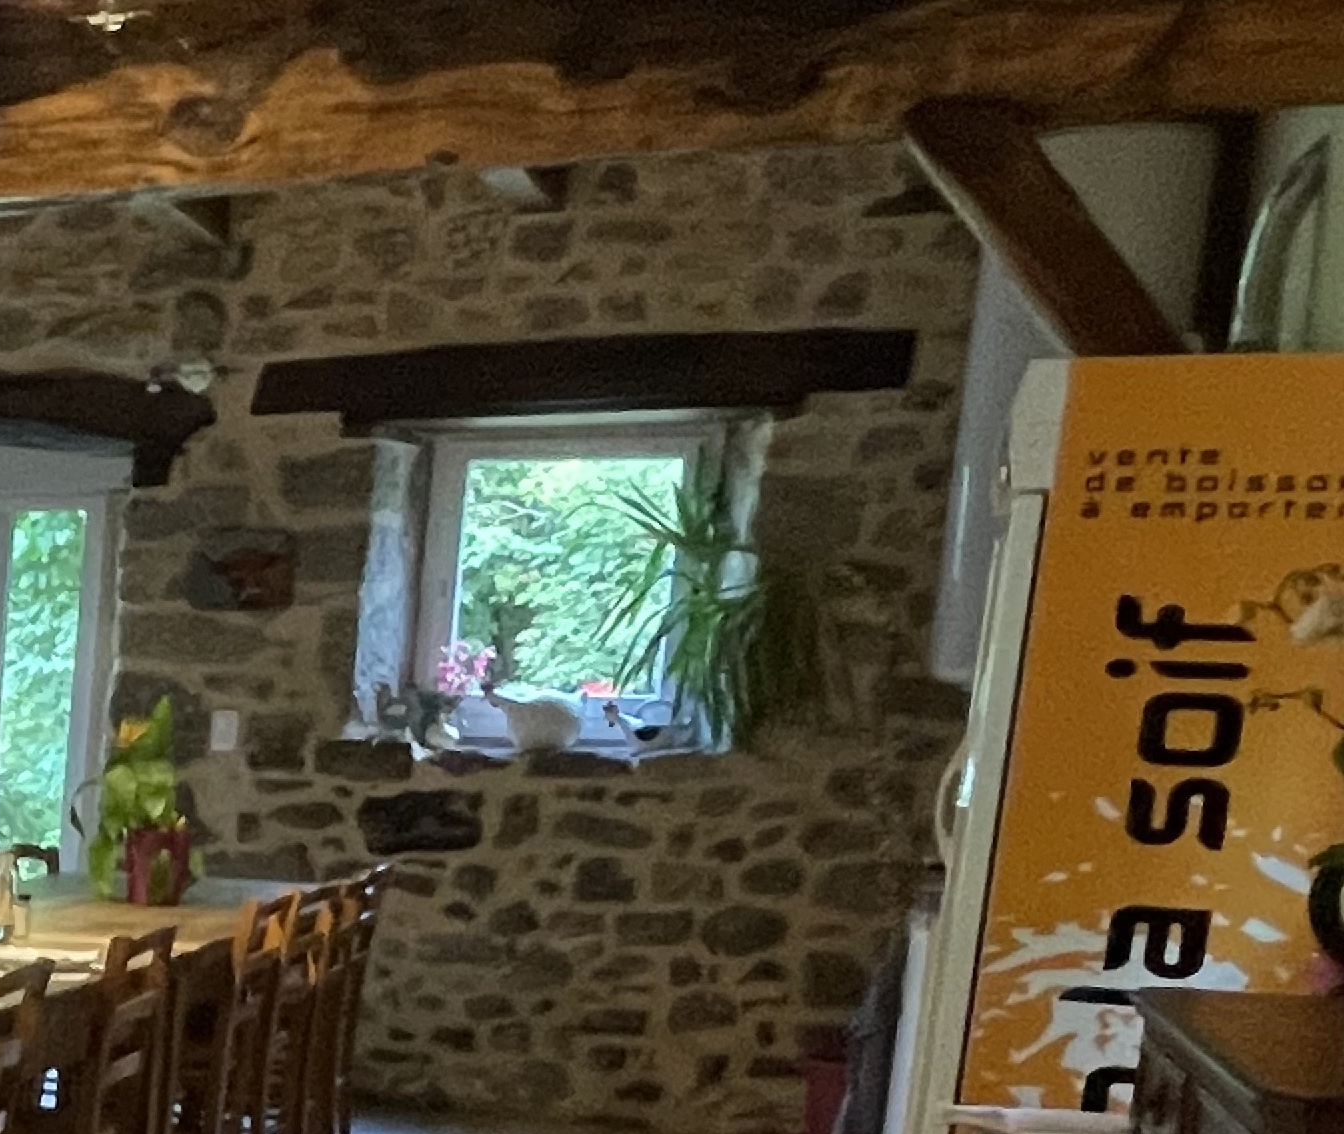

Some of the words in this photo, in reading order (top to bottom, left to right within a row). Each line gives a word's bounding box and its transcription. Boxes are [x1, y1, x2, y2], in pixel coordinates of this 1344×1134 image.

[1089, 449, 1219, 466] vente
[1085, 471, 1135, 492] de
[1165, 467, 1344, 494] boisso
[1080, 497, 1100, 518] à
[1104, 594, 1258, 852] soif
